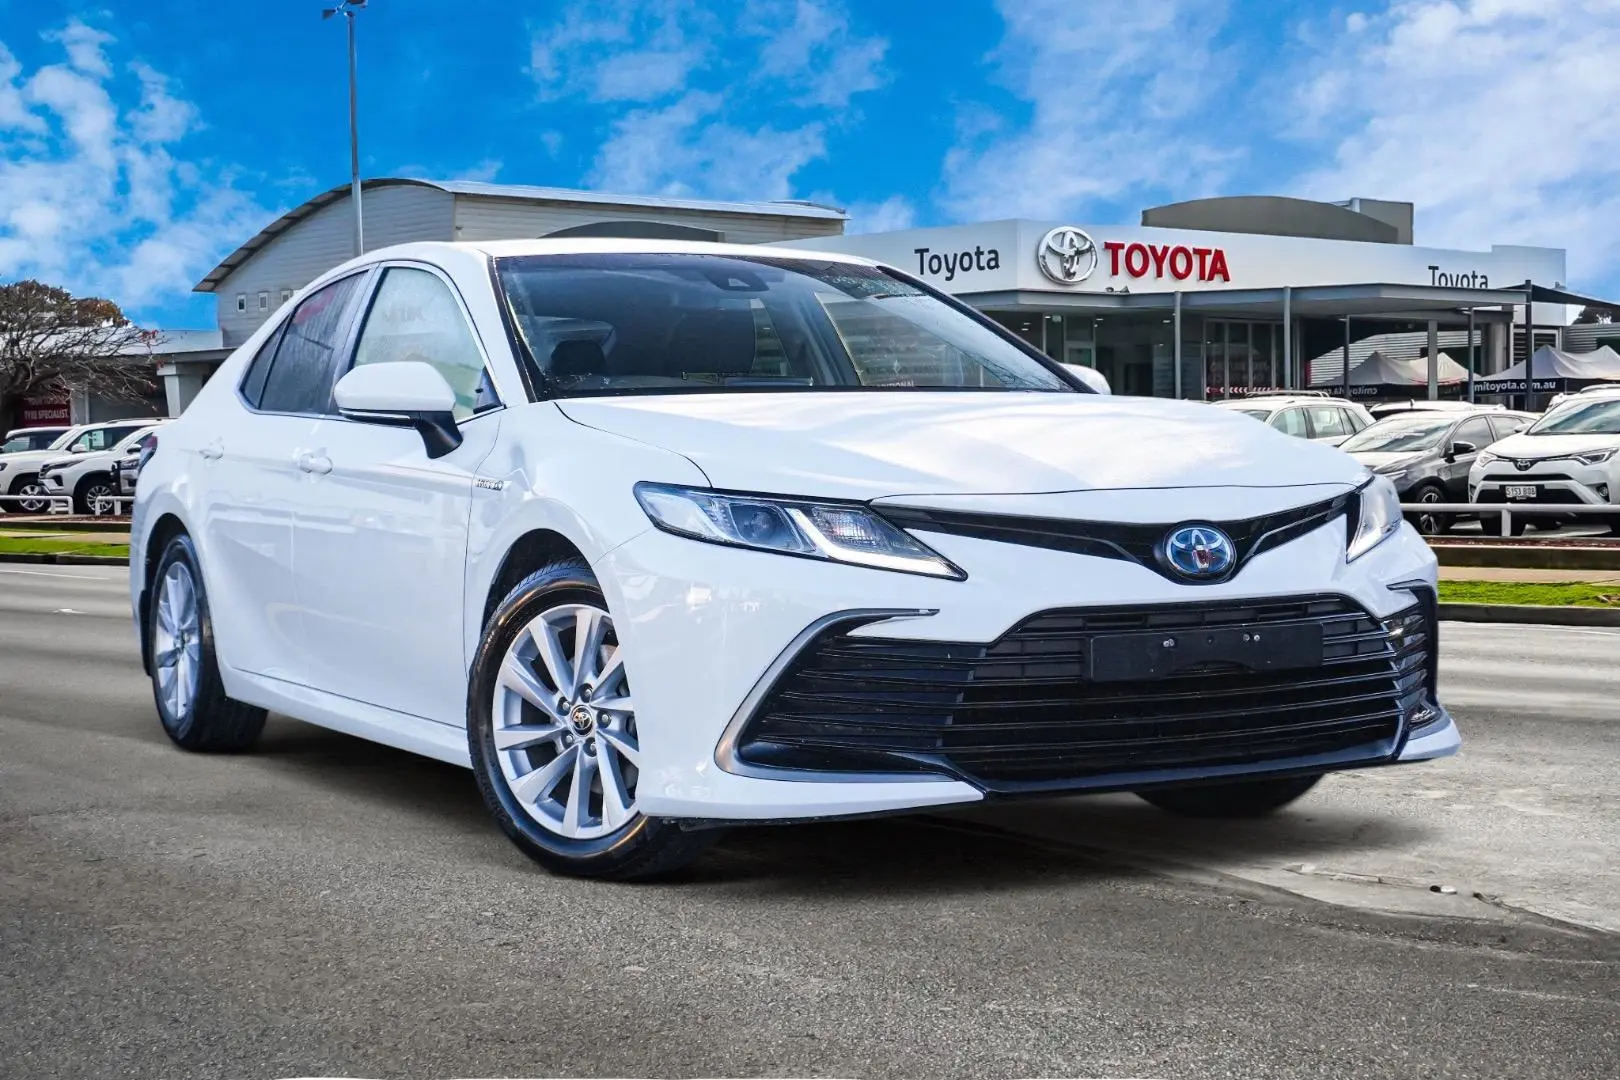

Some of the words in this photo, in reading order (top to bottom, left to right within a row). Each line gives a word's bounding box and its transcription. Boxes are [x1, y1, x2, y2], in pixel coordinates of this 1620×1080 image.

[914, 245, 1000, 281] Toyota
[1104, 241, 1231, 282] TOYOTA
[1428, 265, 1489, 288] Toyota
[1474, 381, 1556, 392] mitoyota.cm.au
